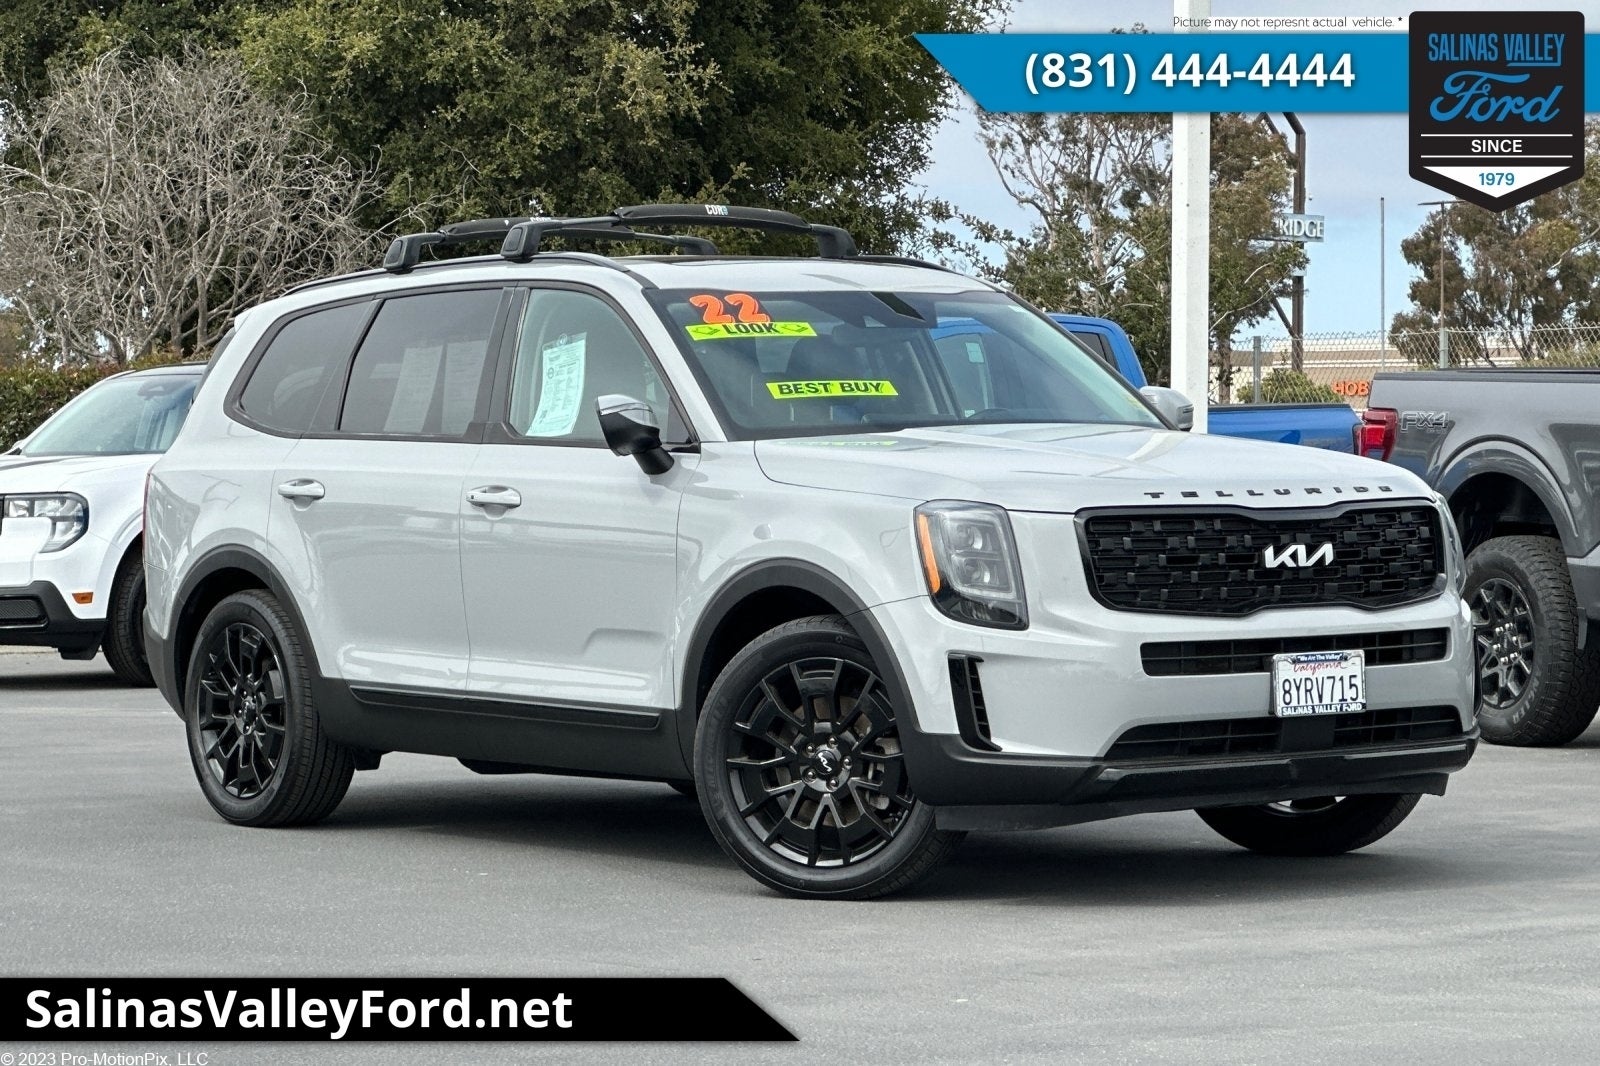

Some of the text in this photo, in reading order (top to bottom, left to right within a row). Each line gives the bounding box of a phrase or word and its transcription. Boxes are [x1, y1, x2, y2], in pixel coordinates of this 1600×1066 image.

[689, 293, 771, 324] 22
[722, 322, 780, 335] LOOK
[777, 381, 885, 395] BEST BUY
[1400, 410, 1450, 433] FX4
[1143, 485, 1393, 499] TELLURIDE
[1264, 543, 1334, 568] KIA
[1293, 661, 1348, 676] California
[1282, 674, 1359, 706] 8YRV715
[1282, 703, 1362, 716] SALINAS VALLEY FORD
